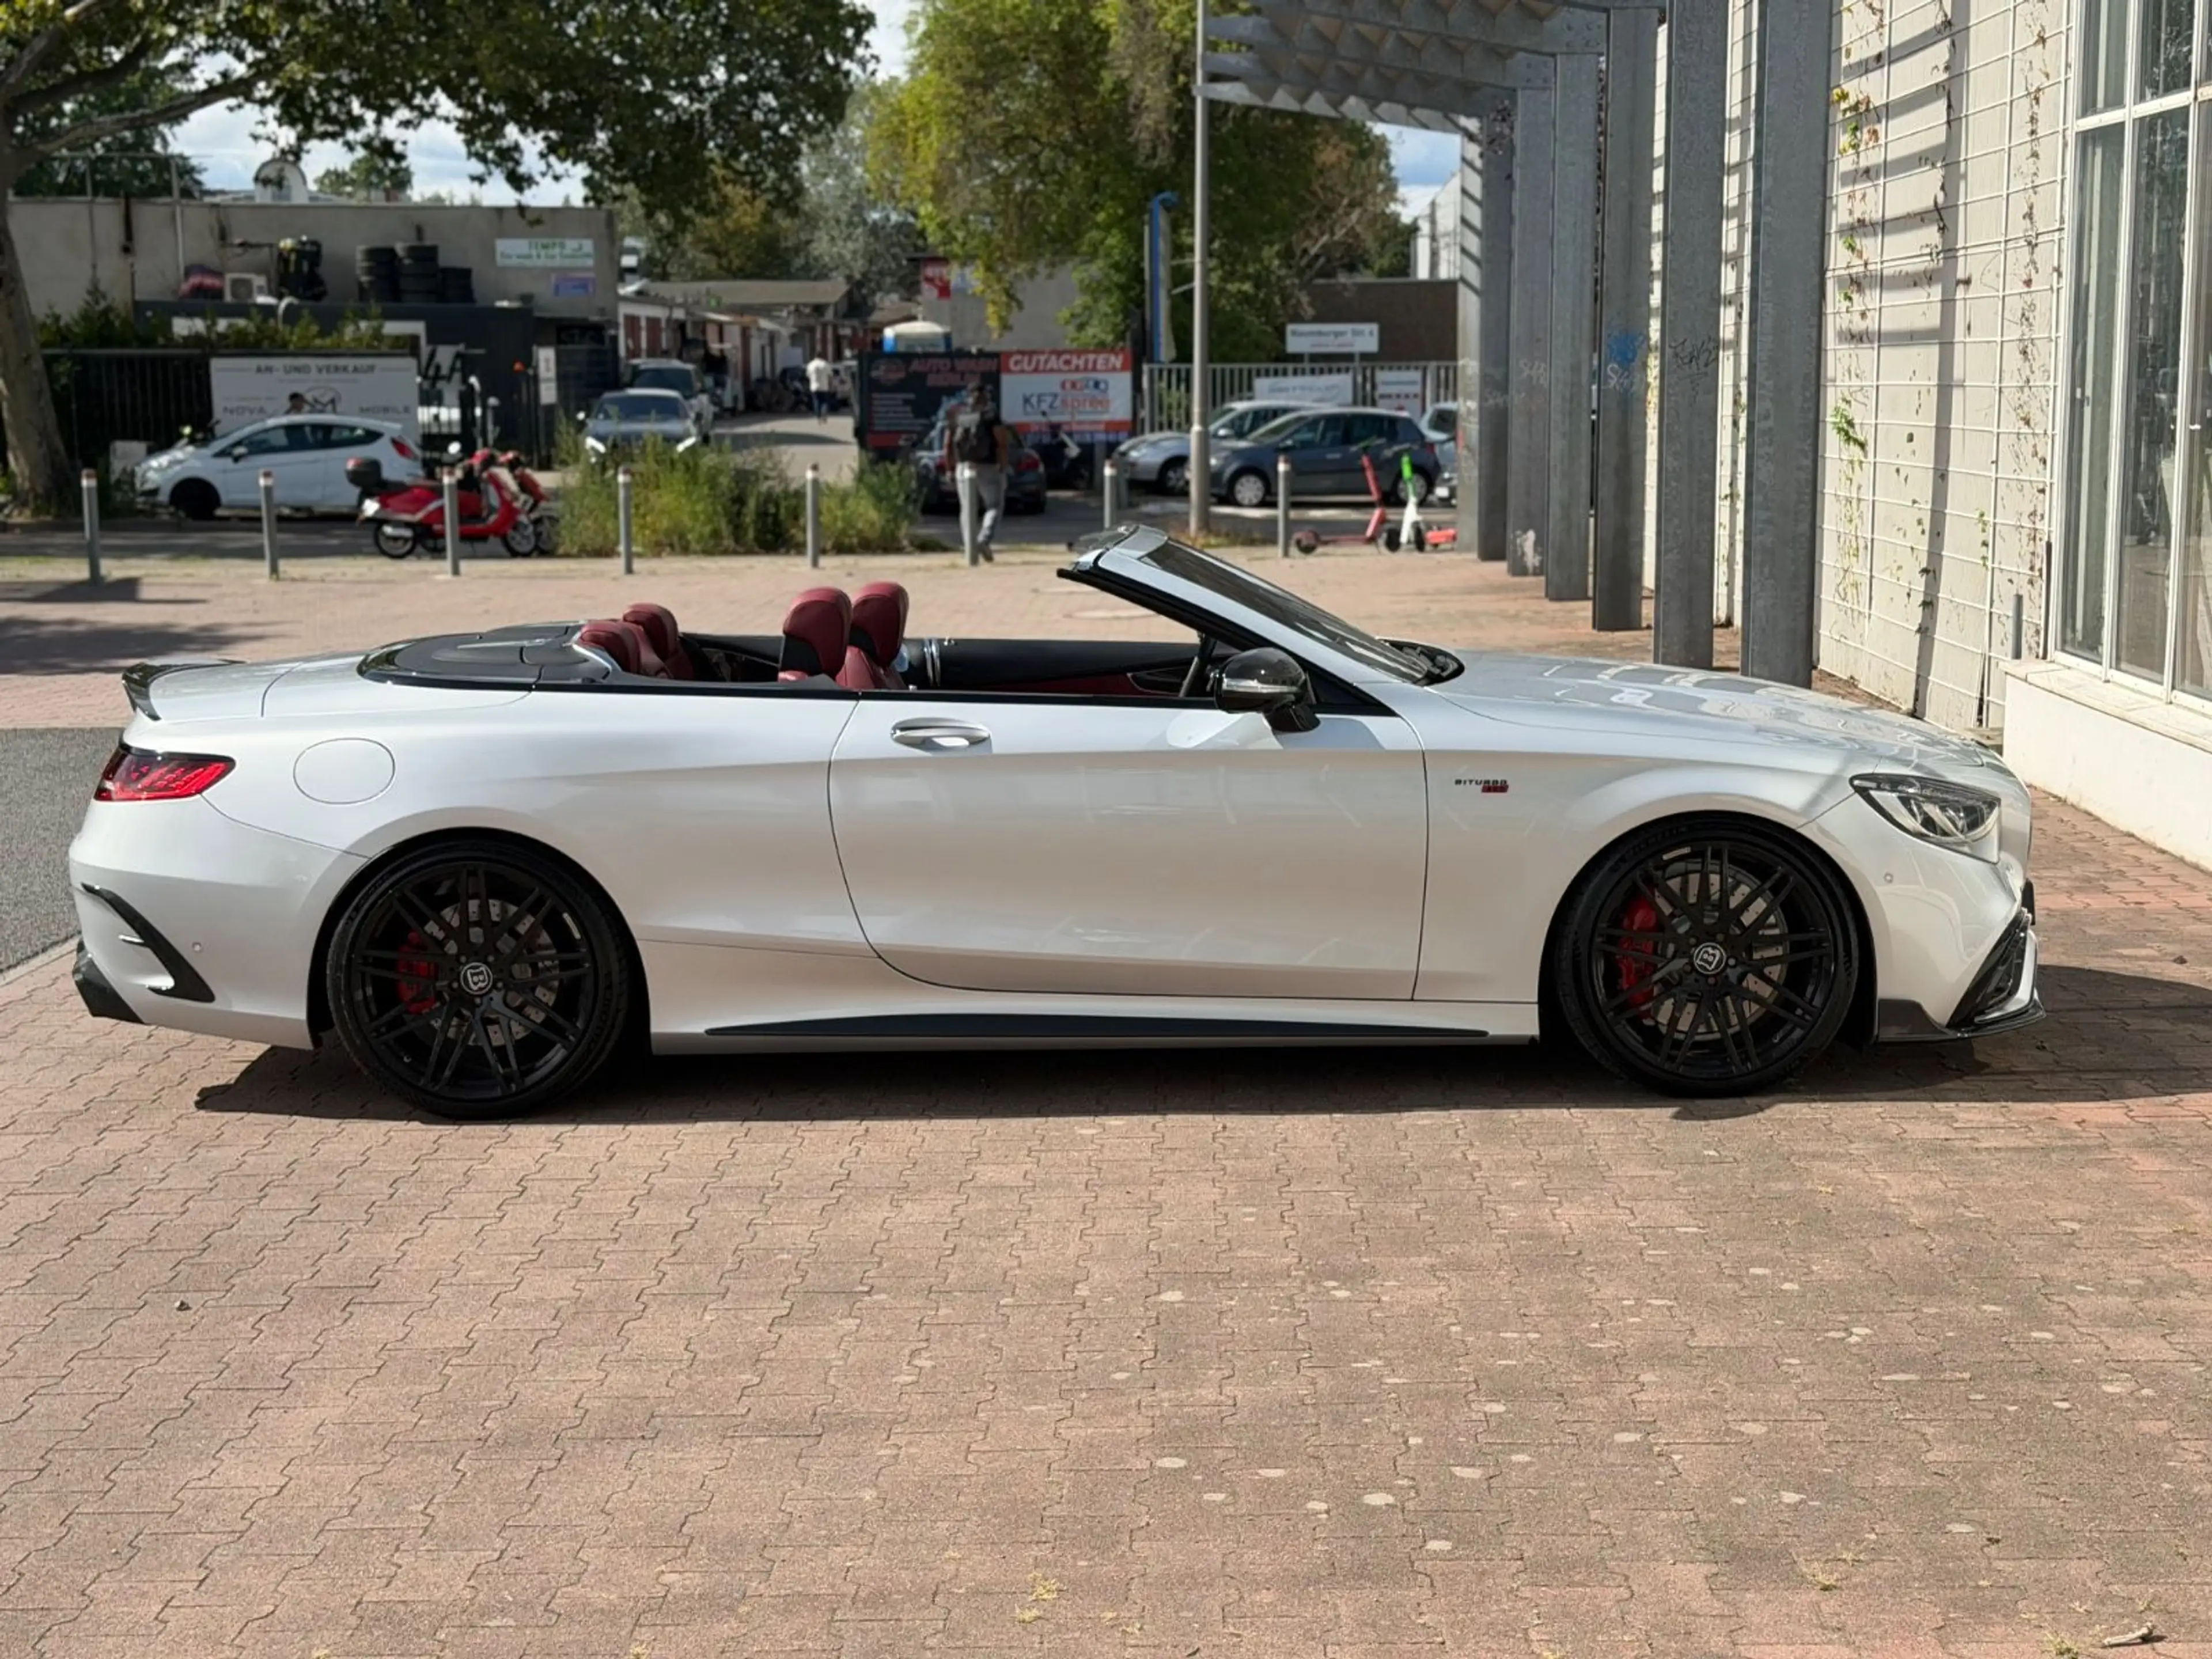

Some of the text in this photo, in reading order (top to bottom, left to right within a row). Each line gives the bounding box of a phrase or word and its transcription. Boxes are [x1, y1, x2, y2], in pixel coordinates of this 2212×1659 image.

[1009, 353, 1124, 372] GUTACHTEN
[283, 364, 312, 374] UND
[316, 364, 377, 374] VERKAUF
[222, 405, 267, 414] NOVA
[358, 405, 411, 414] MOBILE
